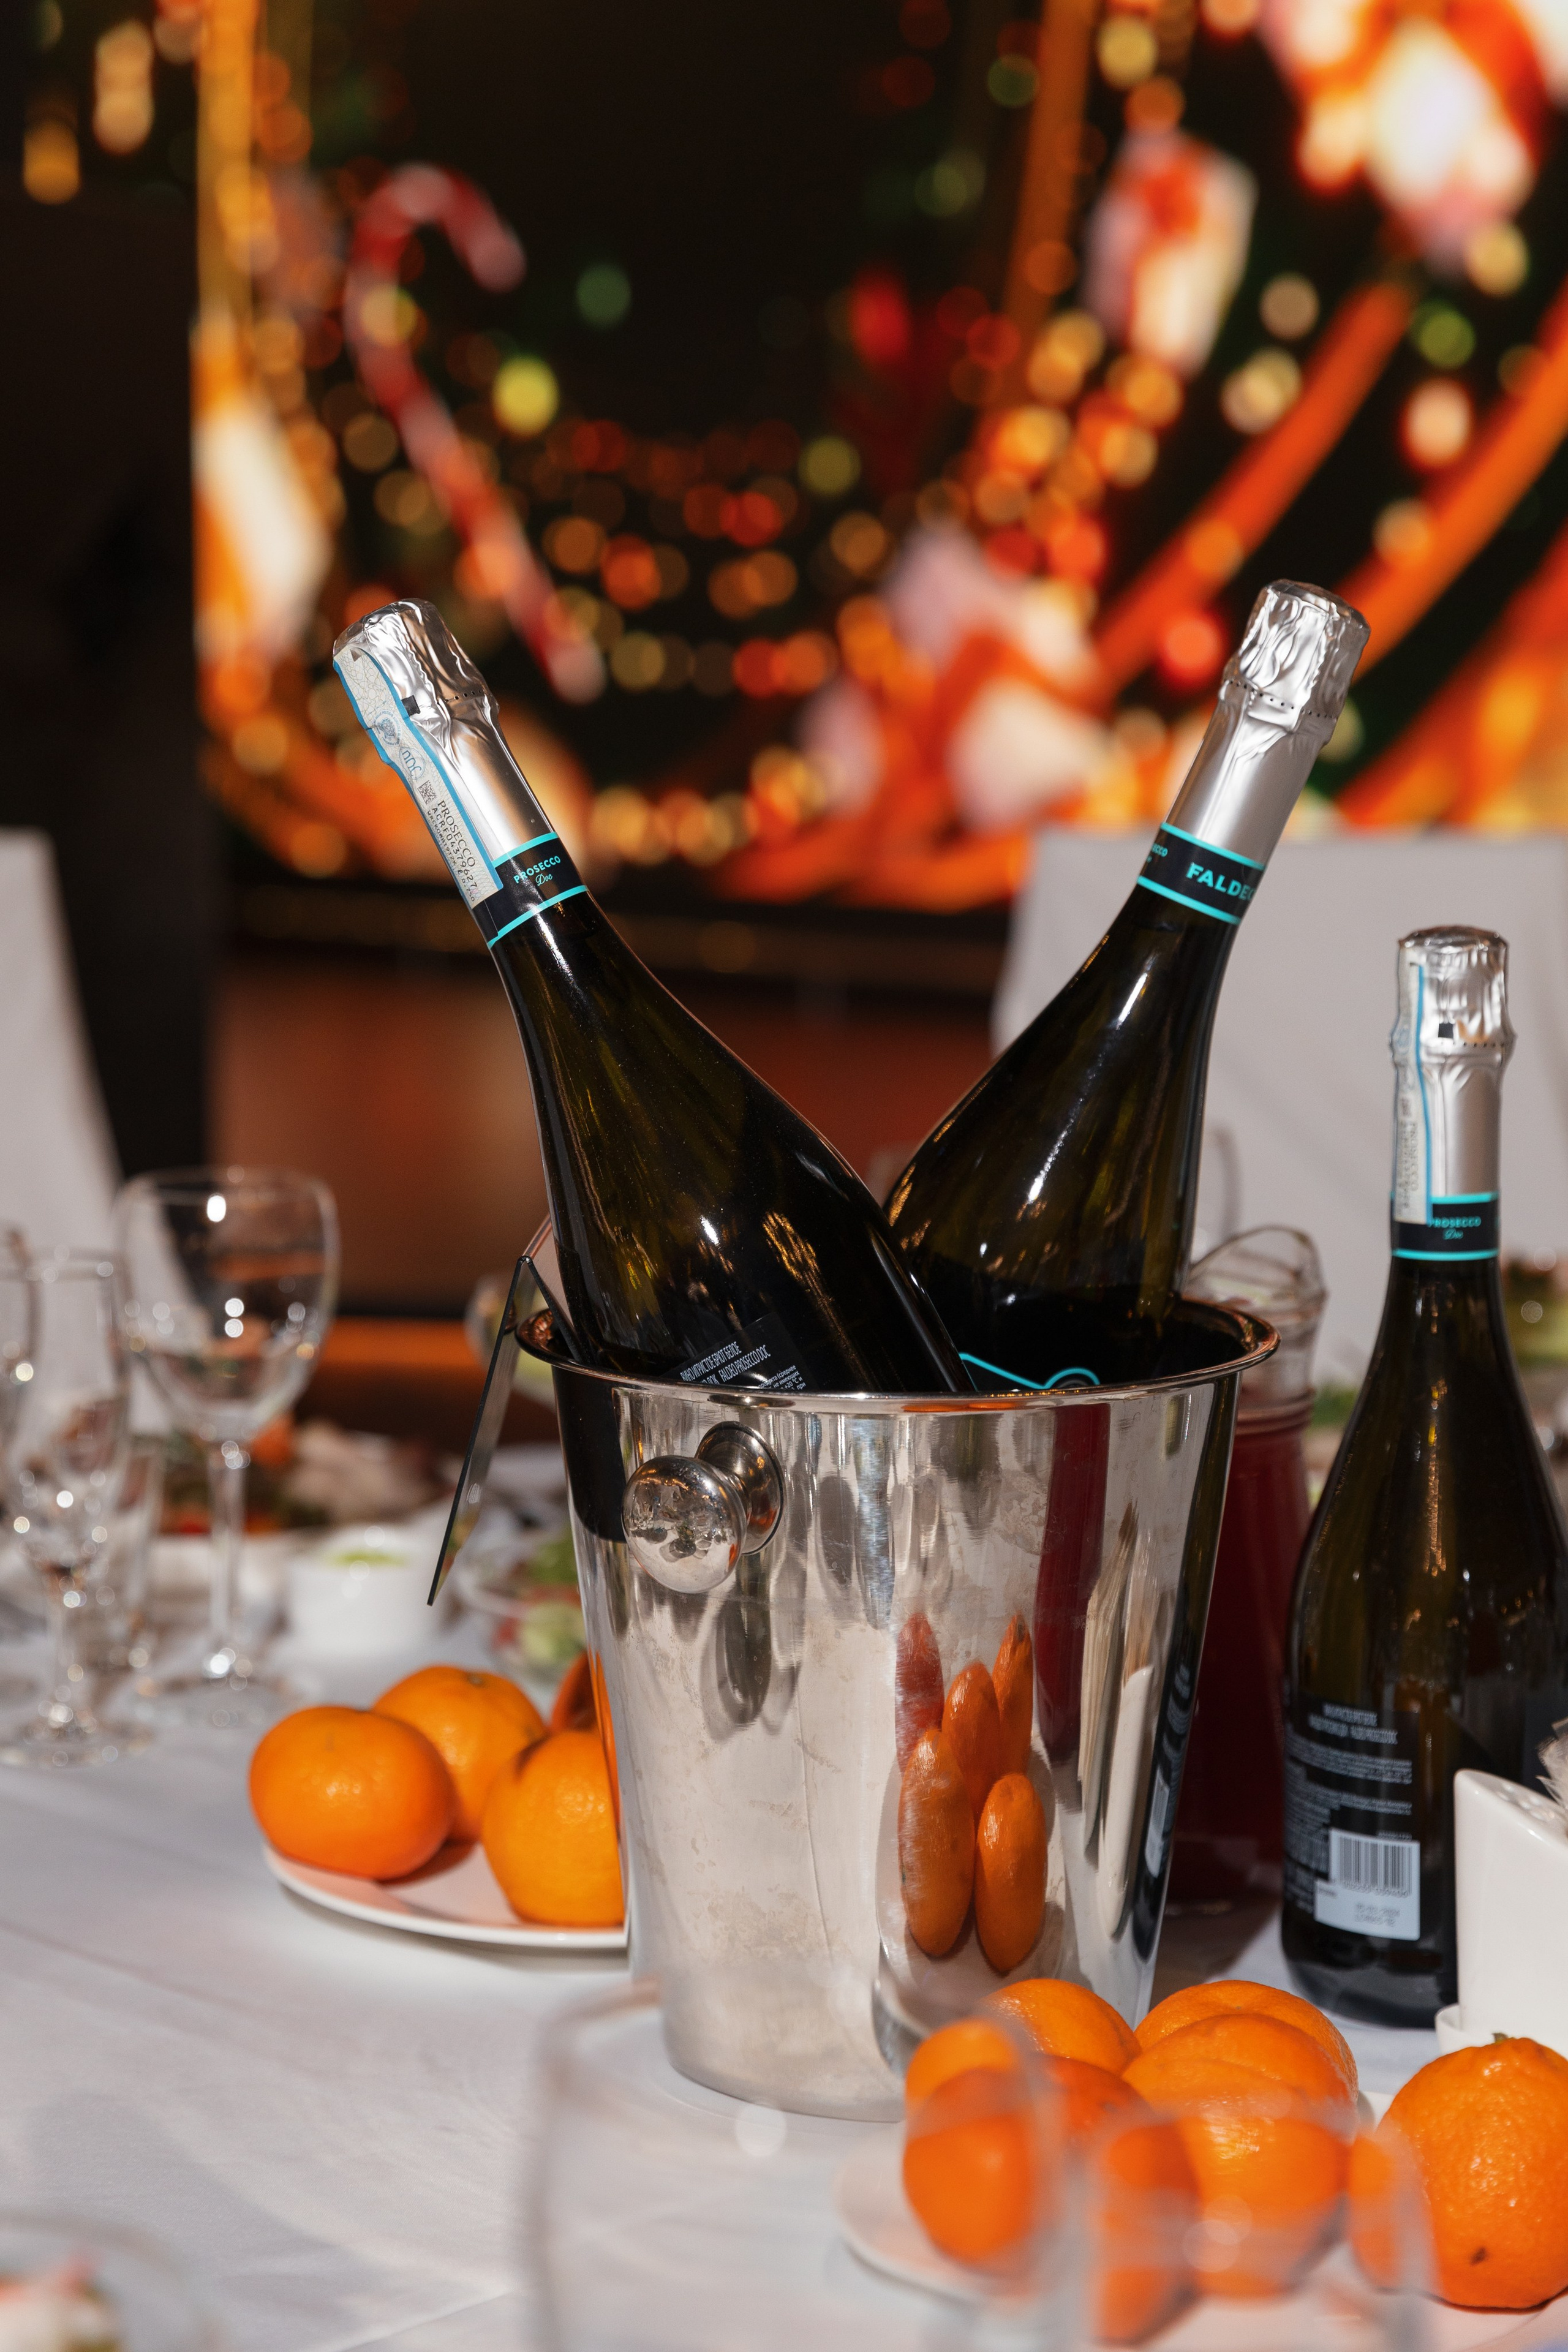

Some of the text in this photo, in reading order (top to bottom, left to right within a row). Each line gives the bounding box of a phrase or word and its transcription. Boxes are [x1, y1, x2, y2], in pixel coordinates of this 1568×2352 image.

[438, 799, 476, 867] PROSECCO
[513, 856, 561, 884] PROSECCO
[535, 873, 553, 886] Doc
[1427, 1216, 1482, 1228] ROSECCO
[691, 1356, 716, 1378] ИГРИСТОЕ
[711, 1349, 727, 1366] БРЮТ
[723, 1341, 742, 1359] БЕЛОЕ
[718, 1363, 739, 1382] FALDEO
[734, 1351, 760, 1373] PROSECCO
[756, 1344, 771, 1361] DOC
[776, 1365, 796, 1379] (среднее
[779, 1371, 800, 1385] имеющих
